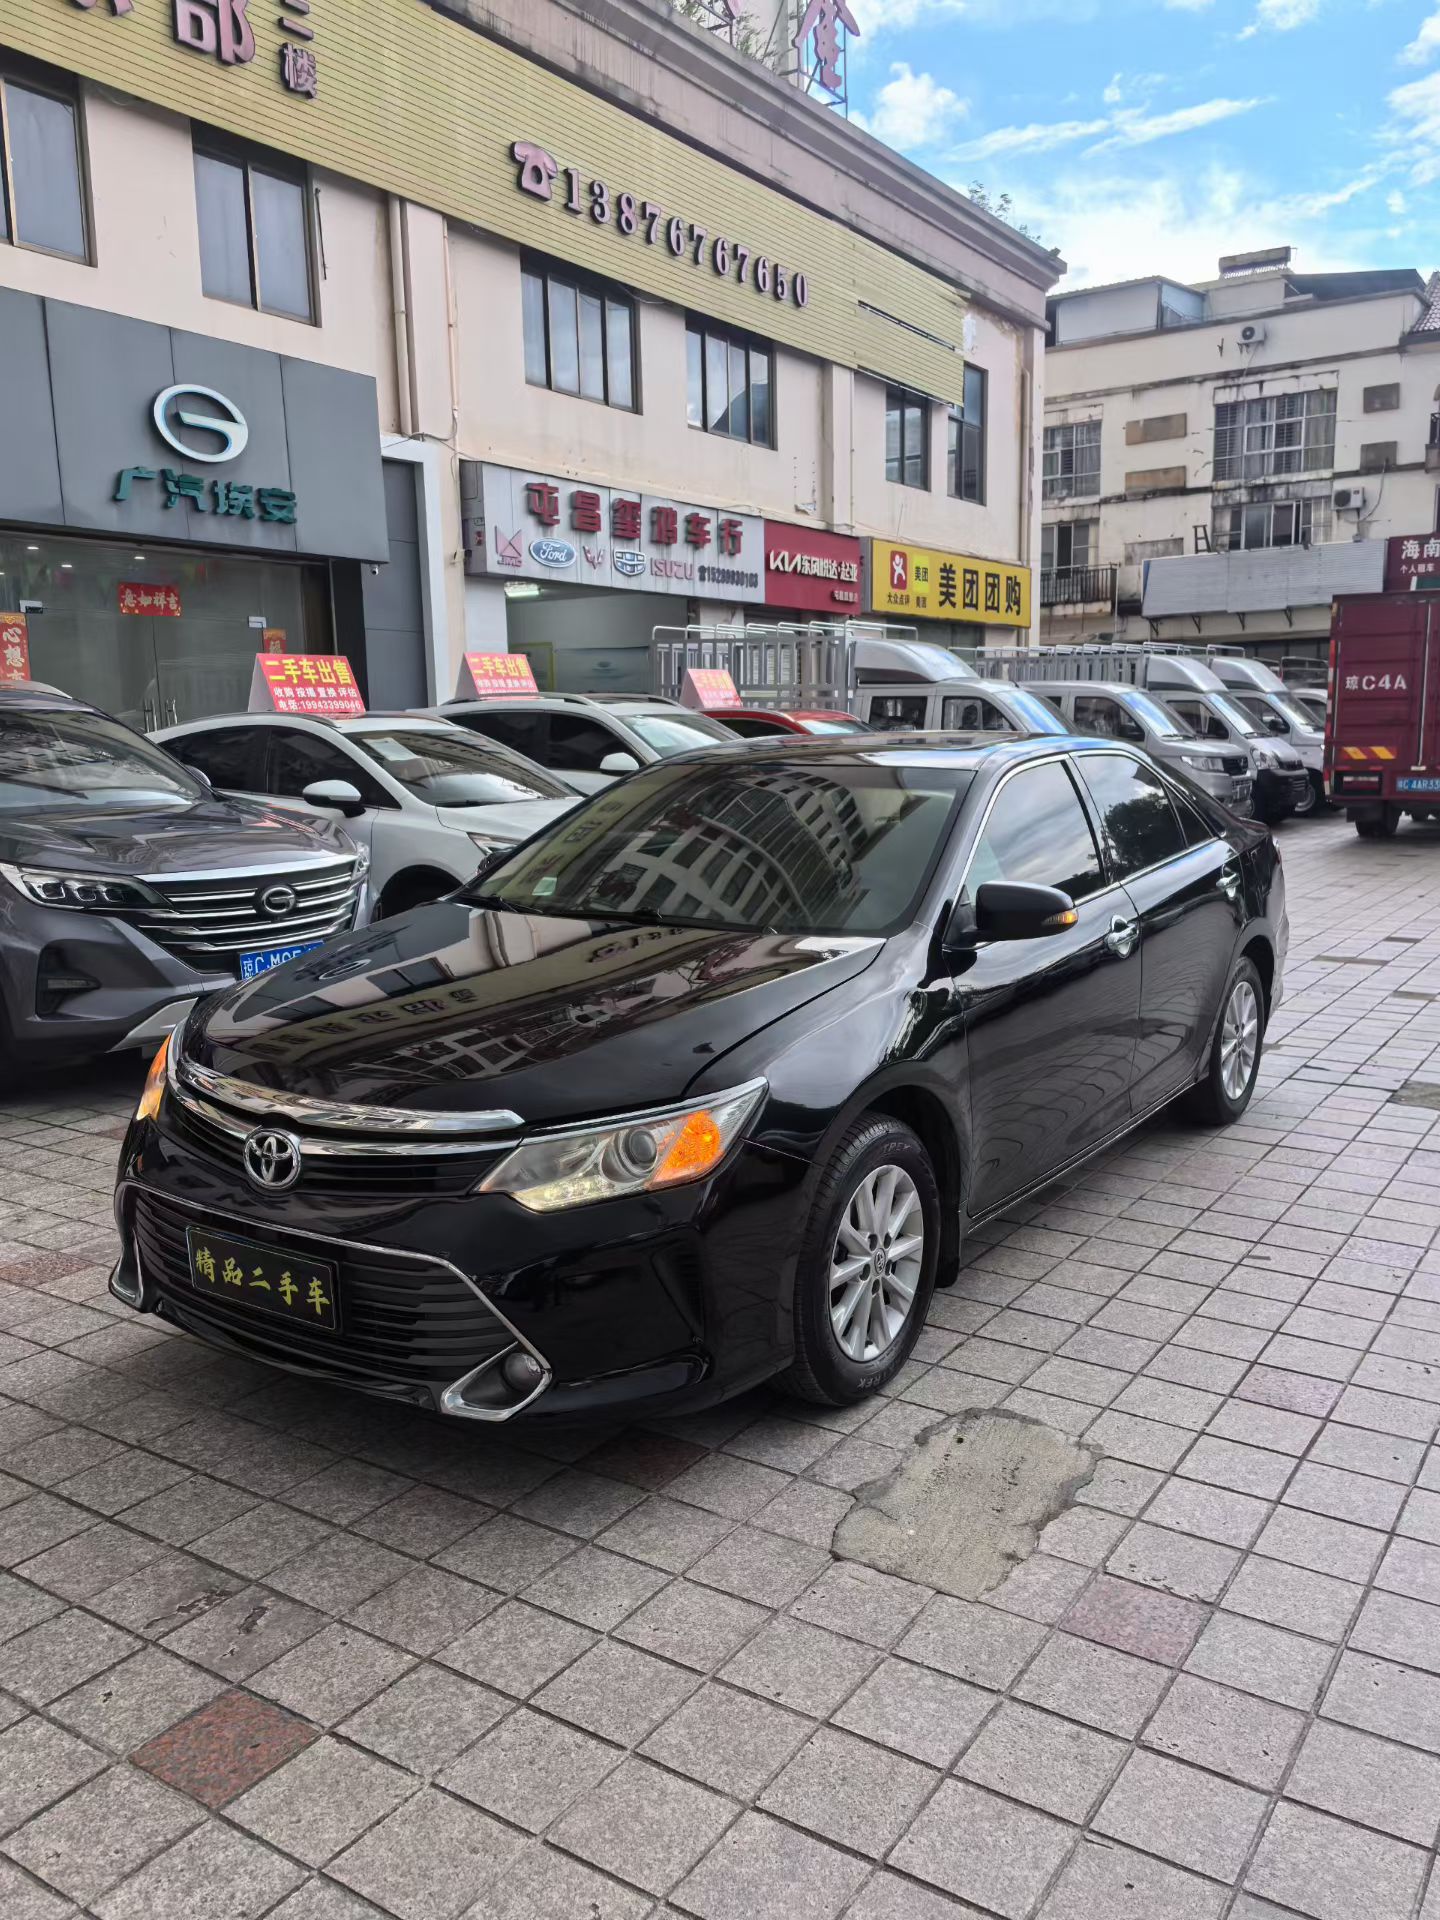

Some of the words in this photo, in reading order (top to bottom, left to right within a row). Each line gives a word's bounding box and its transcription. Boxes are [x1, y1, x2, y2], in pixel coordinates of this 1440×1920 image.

[563, 167, 808, 308] 13876767650
[113, 466, 297, 524] 广汽埃安
[650, 556, 694, 581] ISUZU
[914, 566, 929, 583] 美团
[938, 562, 1022, 616] 美团团购
[265, 658, 352, 684] 二手车出售
[469, 656, 530, 677] 二手车出售
[195, 1245, 331, 1316] 精品二手车
